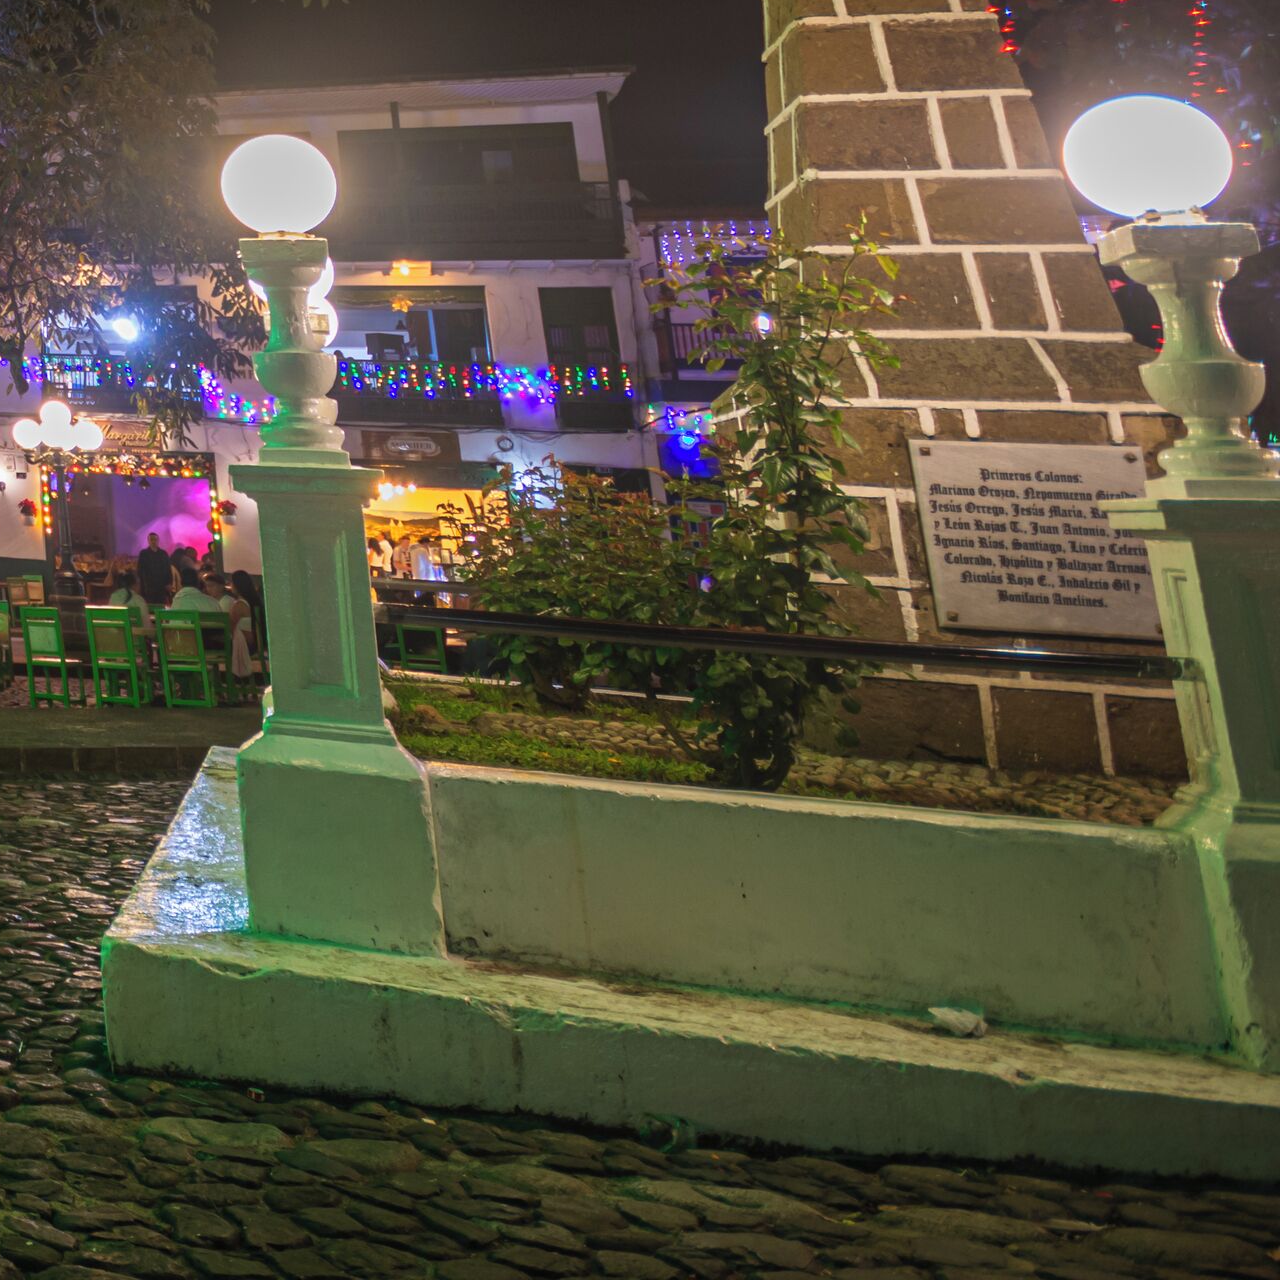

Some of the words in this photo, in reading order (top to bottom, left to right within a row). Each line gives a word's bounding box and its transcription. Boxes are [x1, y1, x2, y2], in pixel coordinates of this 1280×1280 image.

[979, 468, 1032, 482] Primeros
[1034, 470, 1083, 483] Colonos:
[929, 483, 976, 496] Mariano
[978, 485, 1019, 499] Orozco,
[1023, 487, 1093, 501] Nepomuceno
[929, 500, 962, 513] Jesús
[964, 502, 1008, 517] Orrego,
[1011, 503, 1045, 517] Jesús
[934, 520, 940, 530] y
[942, 517, 971, 530] León
[974, 518, 1007, 533] Rojas
[1029, 521, 1059, 535] Juan
[1062, 523, 1109, 538] Antonio,
[933, 534, 975, 549] Ignacio
[977, 536, 1008, 550] Ríos,
[1011, 538, 1066, 554] Santiago,
[1067, 540, 1096, 553] Lino
[1099, 546, 1106, 556] y
[943, 552, 996, 567] Colorado,
[998, 554, 1044, 569] Hipólito
[1046, 560, 1053, 571] y
[1055, 558, 1103, 573] Baltazar
[1105, 560, 1151, 575] Arenas,
[960, 570, 1004, 584] Nicolás
[1057, 575, 1109, 590] Indalecio
[1111, 578, 1131, 592] Gil
[1134, 582, 1141, 593] y
[996, 589, 1050, 605] Bonifacio
